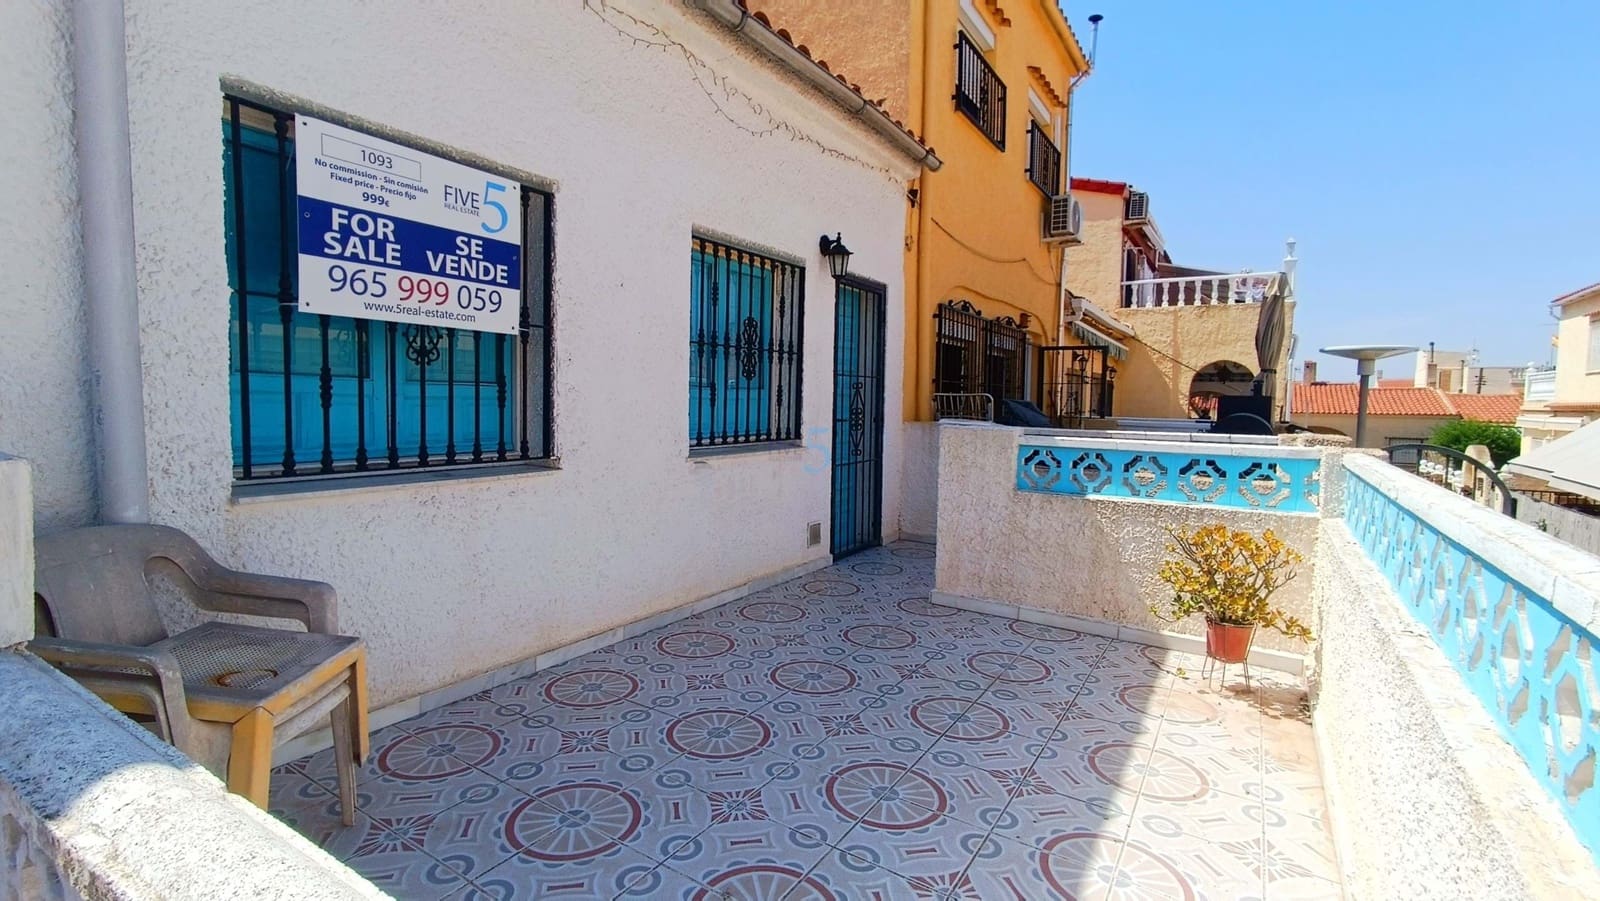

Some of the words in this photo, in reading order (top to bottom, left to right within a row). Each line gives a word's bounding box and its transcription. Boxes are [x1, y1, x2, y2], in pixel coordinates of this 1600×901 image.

[361, 149, 393, 169] 1093
[314, 157, 328, 168] No
[329, 162, 378, 181] commission
[384, 176, 396, 186] Sin
[396, 181, 429, 194] comisión
[330, 172, 353, 184] Fixed
[354, 179, 375, 190] price
[380, 185, 404, 197] Precio
[404, 190, 417, 201] fijo
[362, 191, 390, 208] 999€
[443, 202, 459, 212] REAL
[460, 207, 480, 217] ESTATE
[444, 184, 480, 210] FIVE
[481, 180, 509, 233] 5
[331, 207, 395, 242] FOR
[323, 231, 402, 266] SALE
[455, 235, 484, 259] SE
[425, 250, 509, 285] VENDE
[328, 264, 387, 298] 965
[398, 275, 449, 306] 999
[457, 285, 502, 313] 059
[363, 300, 476, 323] www.5real-estate.com
